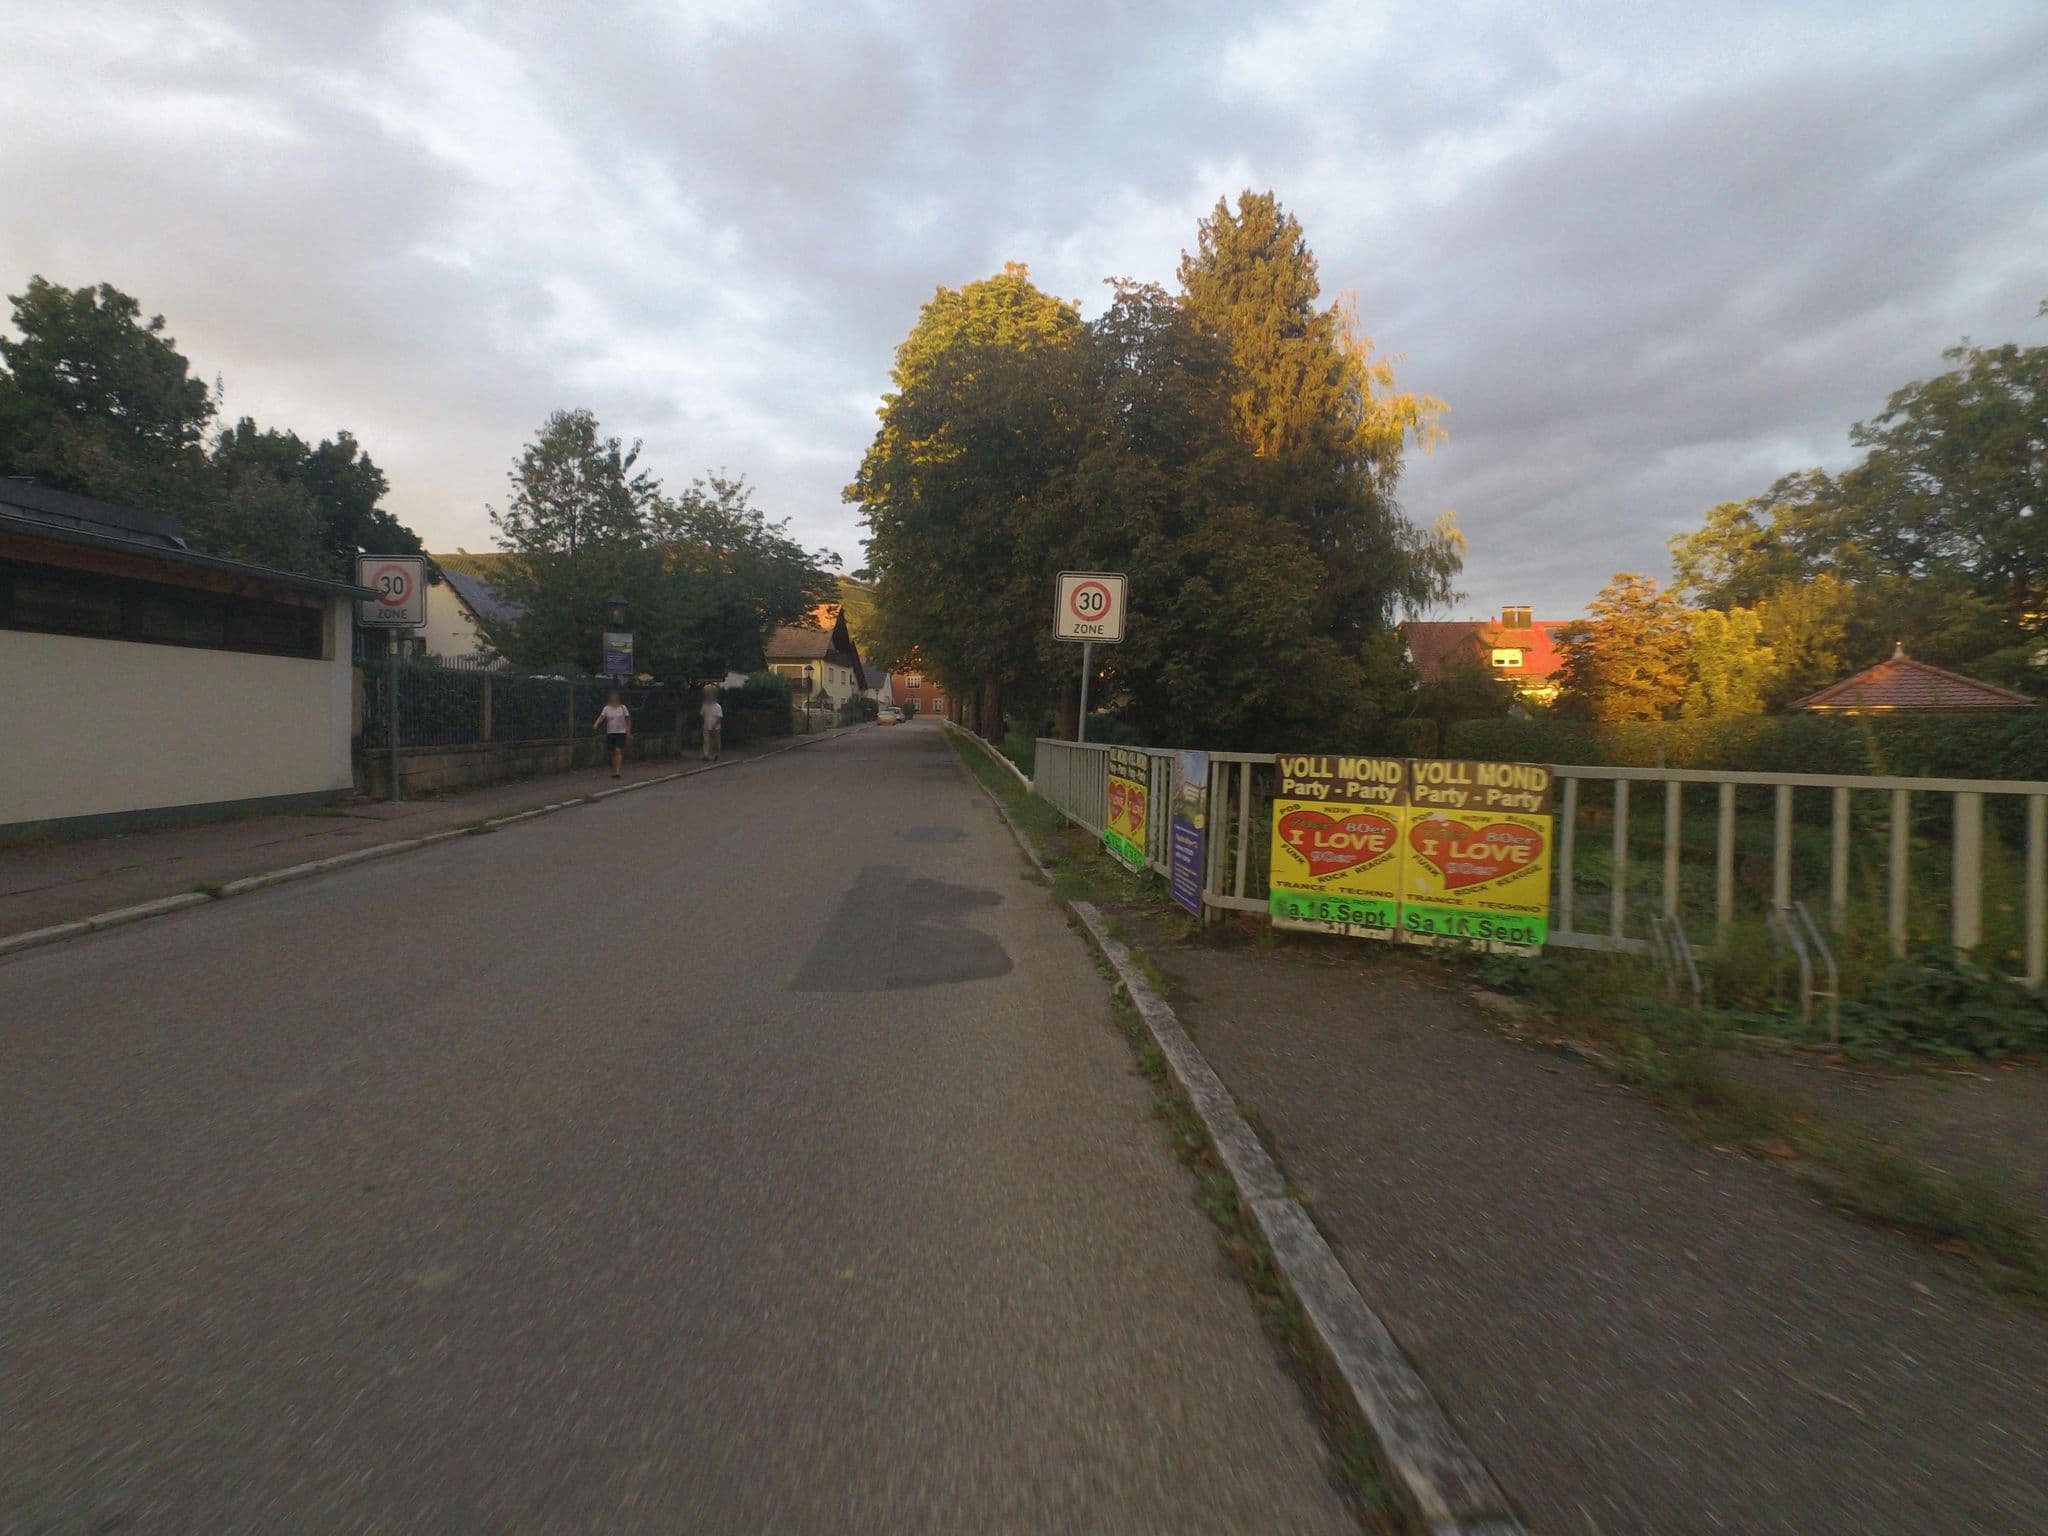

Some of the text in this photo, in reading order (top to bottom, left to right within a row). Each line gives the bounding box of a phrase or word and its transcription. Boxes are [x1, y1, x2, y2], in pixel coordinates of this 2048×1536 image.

[380, 576, 403, 595] 30
[1079, 592, 1103, 611] 30
[378, 608, 407, 619] ZONE
[1073, 623, 1104, 634] ZONE
[1281, 757, 1401, 784] VOLL MOND
[1412, 762, 1548, 792] VOLL MOND
[1282, 778, 1330, 800] Party
[1346, 782, 1397, 803] Party
[1415, 785, 1468, 808] Party
[1487, 789, 1544, 812] Party
[1288, 830, 1387, 852] I LOVE
[1422, 839, 1530, 864] I LOVE
[1317, 872, 1349, 883] ROCK
[1276, 880, 1326, 892] TRANCE
[1340, 887, 1394, 898] TECHNO
[1407, 894, 1463, 905] TRANCE
[1478, 901, 1541, 913] TECHNO
